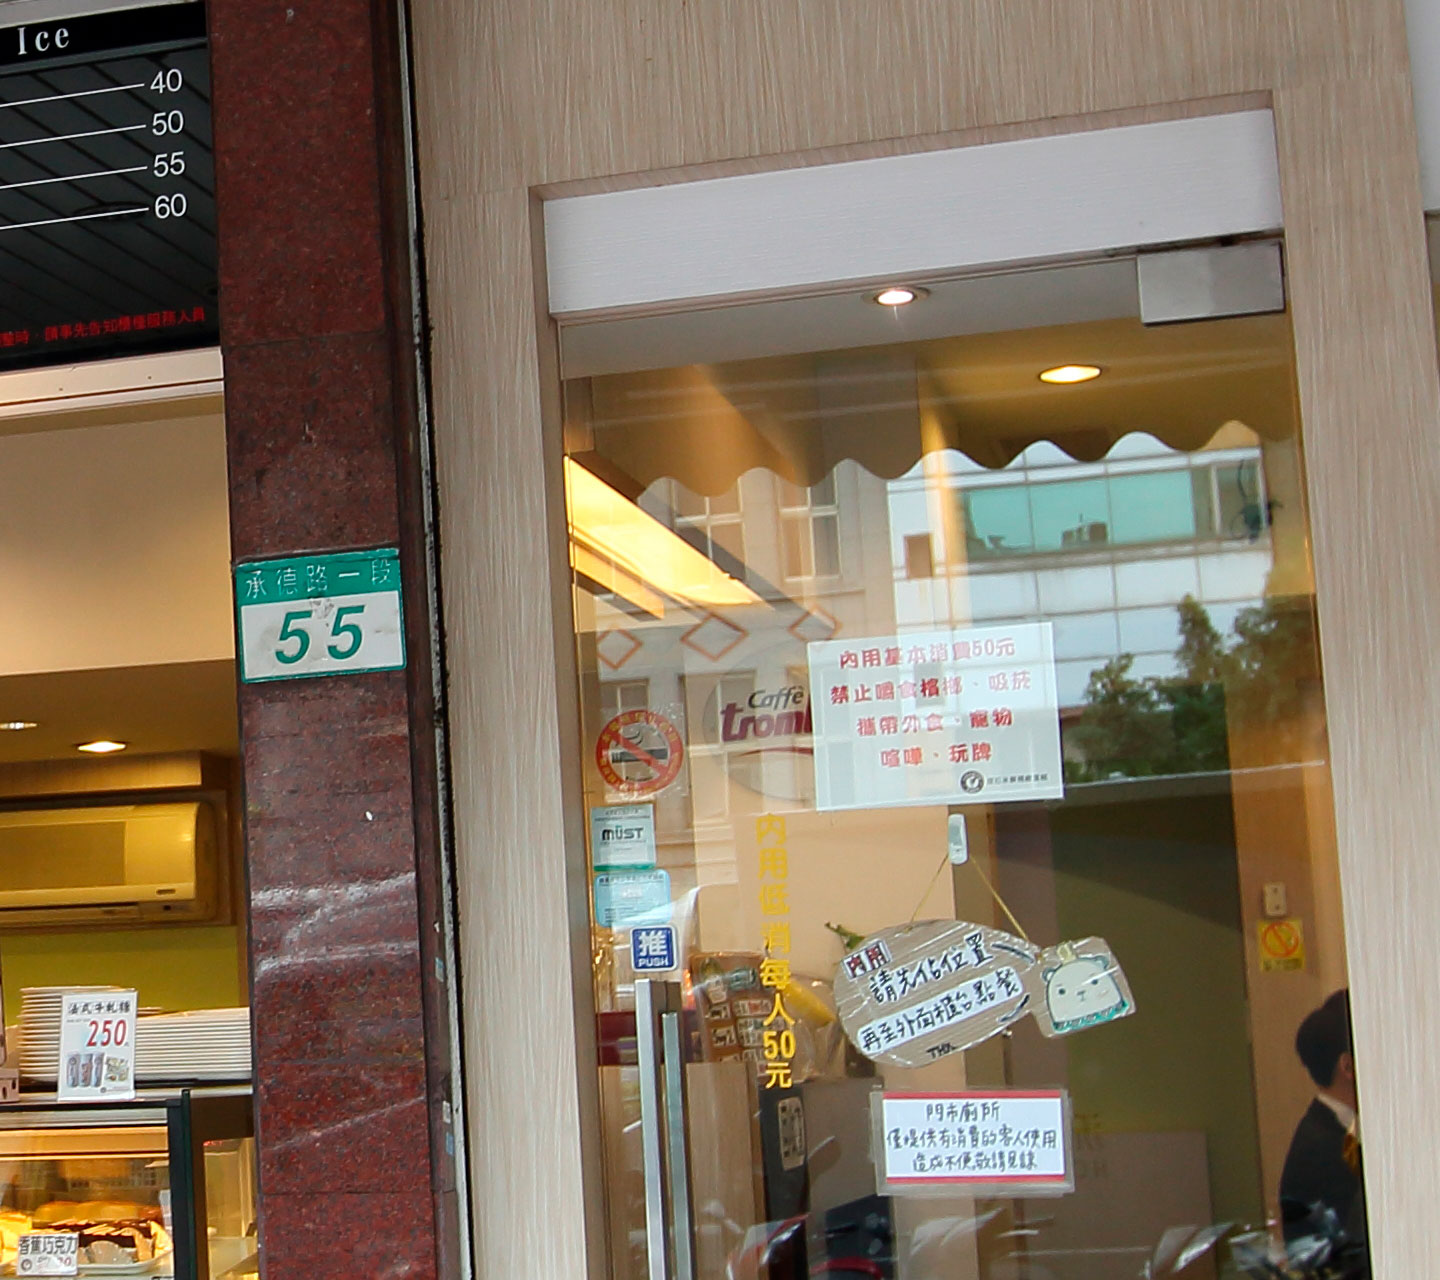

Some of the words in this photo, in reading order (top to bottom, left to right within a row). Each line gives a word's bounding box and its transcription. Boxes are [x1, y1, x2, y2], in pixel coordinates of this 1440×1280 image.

[17, 27, 70, 55] Ice
[149, 69, 183, 95] 40
[151, 111, 185, 136] 50
[152, 152, 186, 178] 55
[153, 194, 187, 219] 60
[245, 558, 392, 598] 承德路一段
[275, 605, 365, 664] 55
[839, 637, 1017, 669] 內用基本消費50元
[748, 685, 804, 710] Caffè
[719, 695, 814, 743] trom
[638, 929, 668, 957] 推
[638, 958, 669, 968] PUSH
[846, 945, 887, 978] 內用
[86, 1018, 127, 1047] 250
